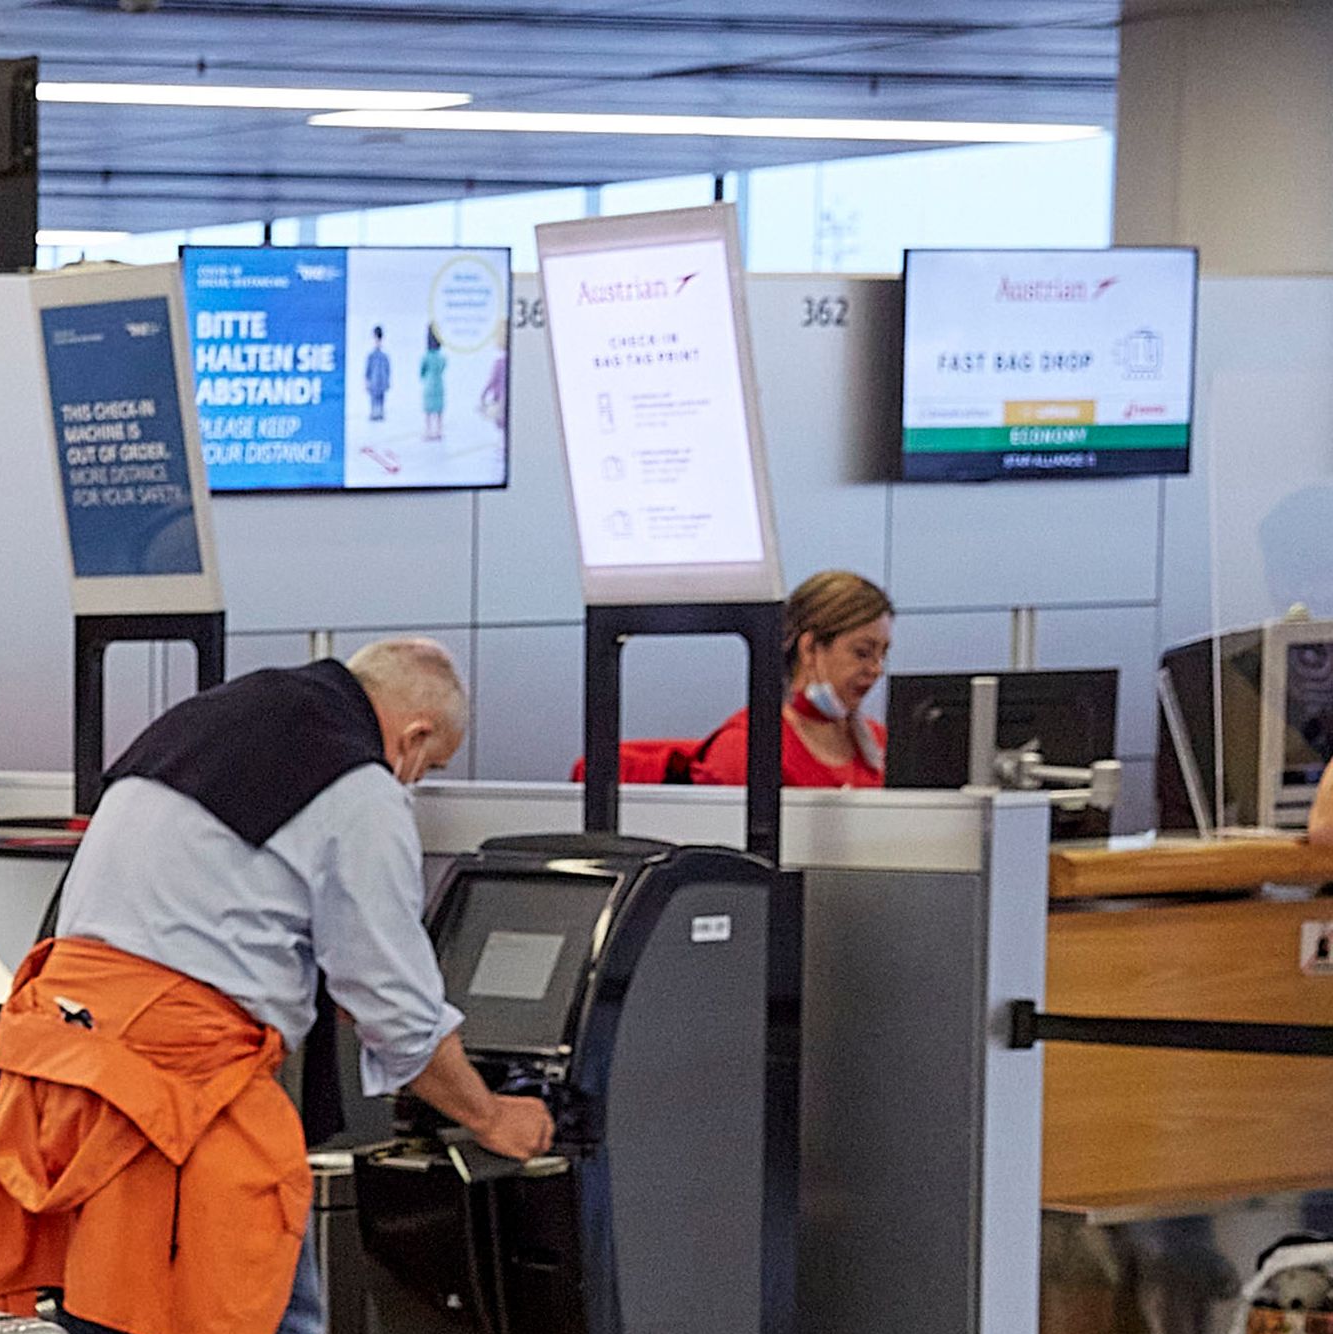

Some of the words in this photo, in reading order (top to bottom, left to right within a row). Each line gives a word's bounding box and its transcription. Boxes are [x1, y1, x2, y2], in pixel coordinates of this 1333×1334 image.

[578, 278, 669, 305] Austrian
[196, 310, 267, 339] BITTE
[801, 298, 851, 328] 362
[196, 343, 294, 373] HALTEN
[296, 343, 335, 373] SIE
[195, 376, 322, 406] ABSTAND!
